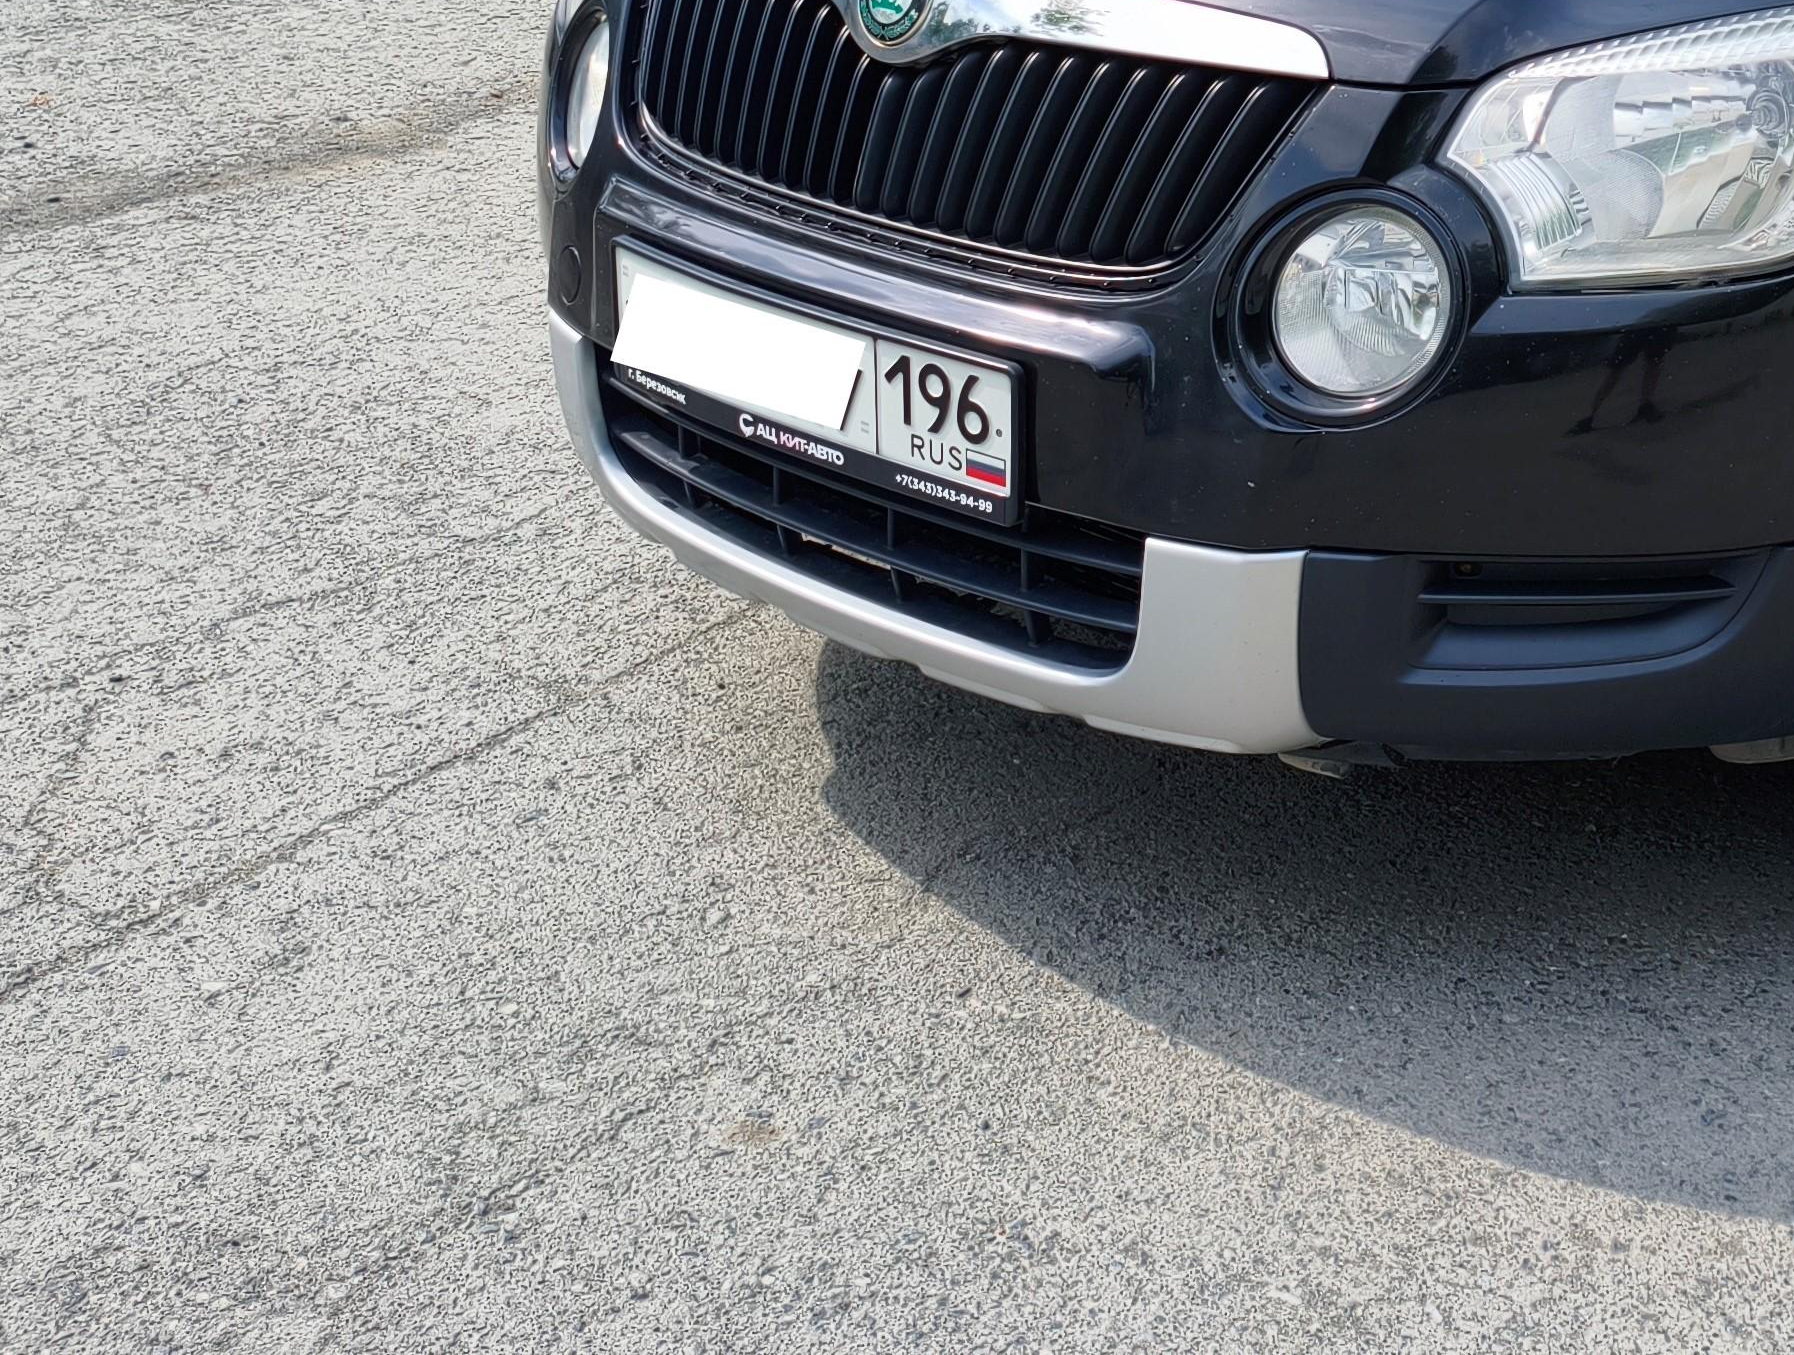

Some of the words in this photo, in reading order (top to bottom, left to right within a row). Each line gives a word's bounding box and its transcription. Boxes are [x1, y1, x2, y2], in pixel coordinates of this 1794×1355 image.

[884, 354, 990, 445] 196
[756, 422, 778, 445] АЦ
[780, 430, 845, 466] КИТ-АВТО
[910, 433, 963, 471] RUS
